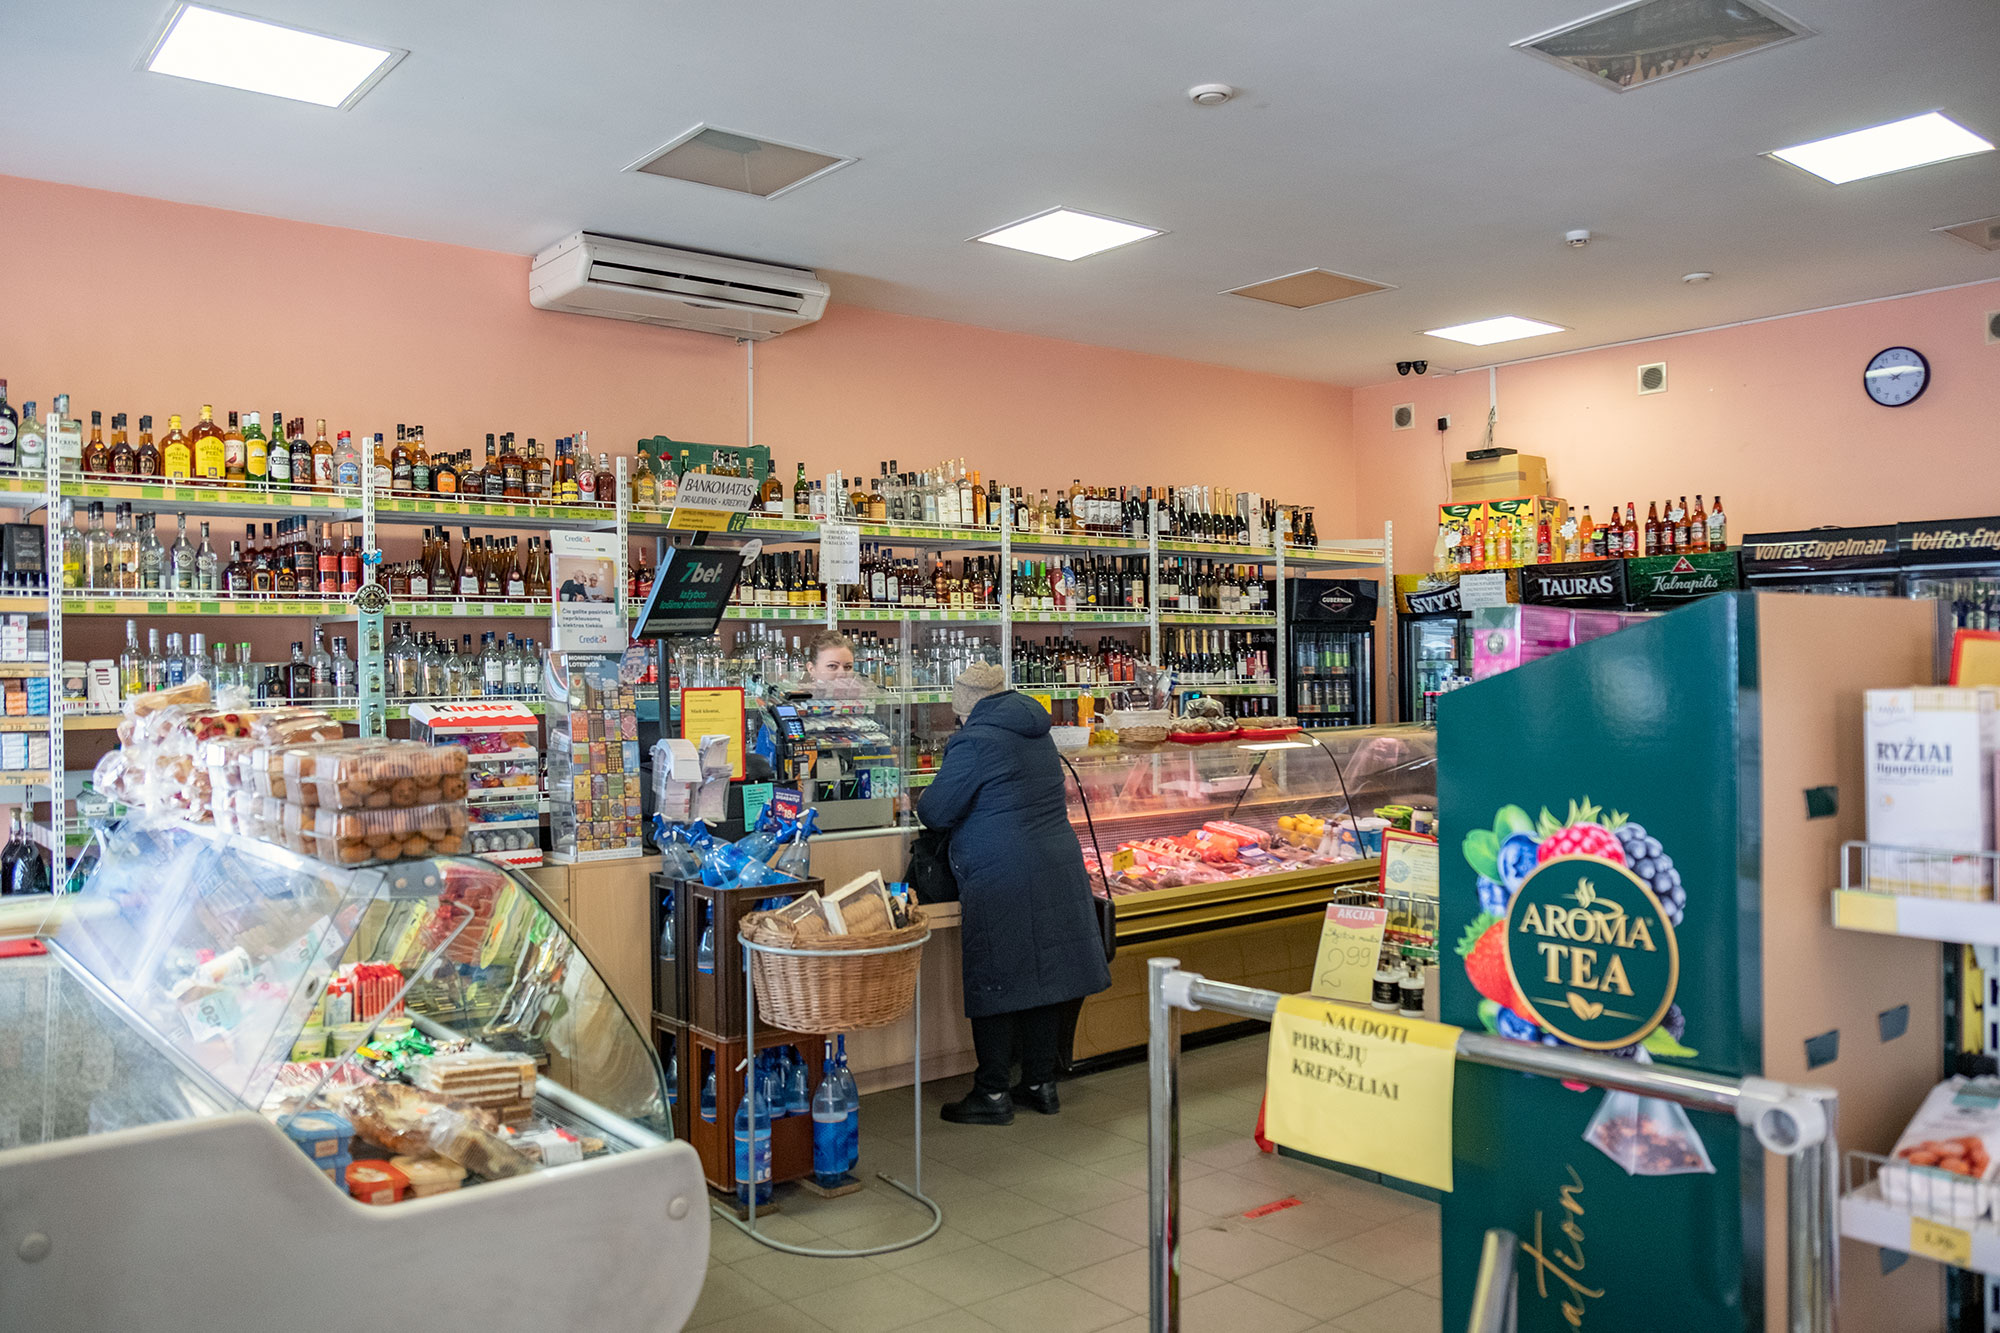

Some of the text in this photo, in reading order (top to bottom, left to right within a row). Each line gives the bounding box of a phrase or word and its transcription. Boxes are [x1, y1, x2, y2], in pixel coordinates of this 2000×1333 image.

[685, 478, 753, 497] BANKOMATAS
[564, 535, 591, 543] Credit24
[1538, 576, 1614, 597] TAURAS
[1651, 574, 1718, 594] Kalnapilis
[579, 635, 607, 644] Credit24
[1877, 736, 1952, 762] RYŽIAI
[1337, 908, 1375, 921] AKCIJA
[1518, 902, 1657, 952] AROMA
[1537, 942, 1635, 996] TEA
[1325, 1011, 1409, 1044] NAUDOTI
[1292, 1031, 1368, 1067] PIRKĖJŲ
[1292, 1058, 1400, 1100] KREPŠELIAI
